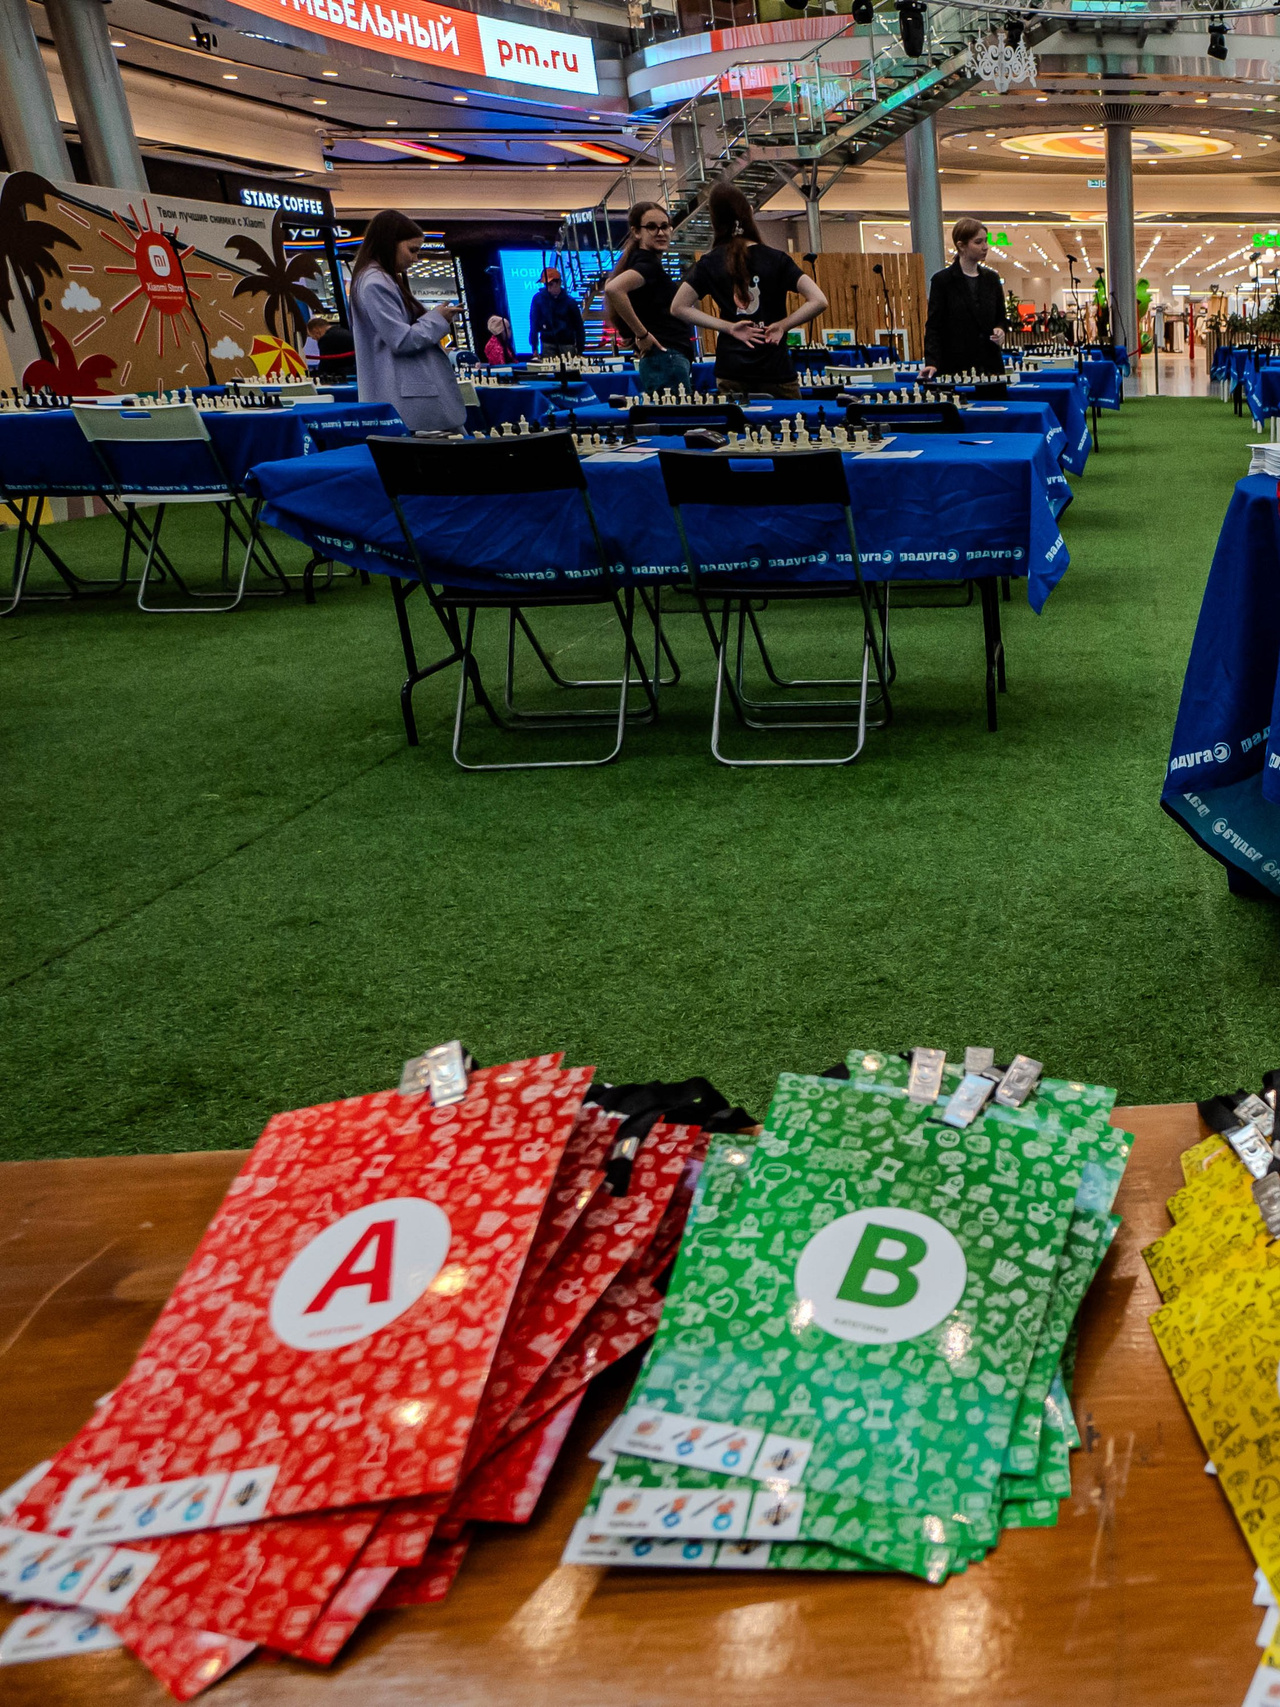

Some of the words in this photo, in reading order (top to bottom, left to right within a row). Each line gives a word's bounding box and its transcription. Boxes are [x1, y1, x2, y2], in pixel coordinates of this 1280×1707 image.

[497, 37, 579, 73] pm.ru
[242, 190, 281, 209] STARS
[283, 196, 324, 216] COFFEE
[157, 206, 176, 219] Твои
[178, 210, 208, 225] лучшие
[210, 215, 237, 227] снимки
[243, 217, 267, 230] Xiaomi
[146, 282, 167, 293] Xiaomi
[168, 283, 185, 293] Store
[632, 564, 680, 575] радуга
[700, 560, 748, 572] радуга
[768, 555, 817, 567] радуга
[836, 551, 881, 563] рауга
[900, 551, 946, 562] радуга
[966, 550, 1012, 560] радуга
[301, 1218, 398, 1315] A
[836, 1222, 928, 1309] B
